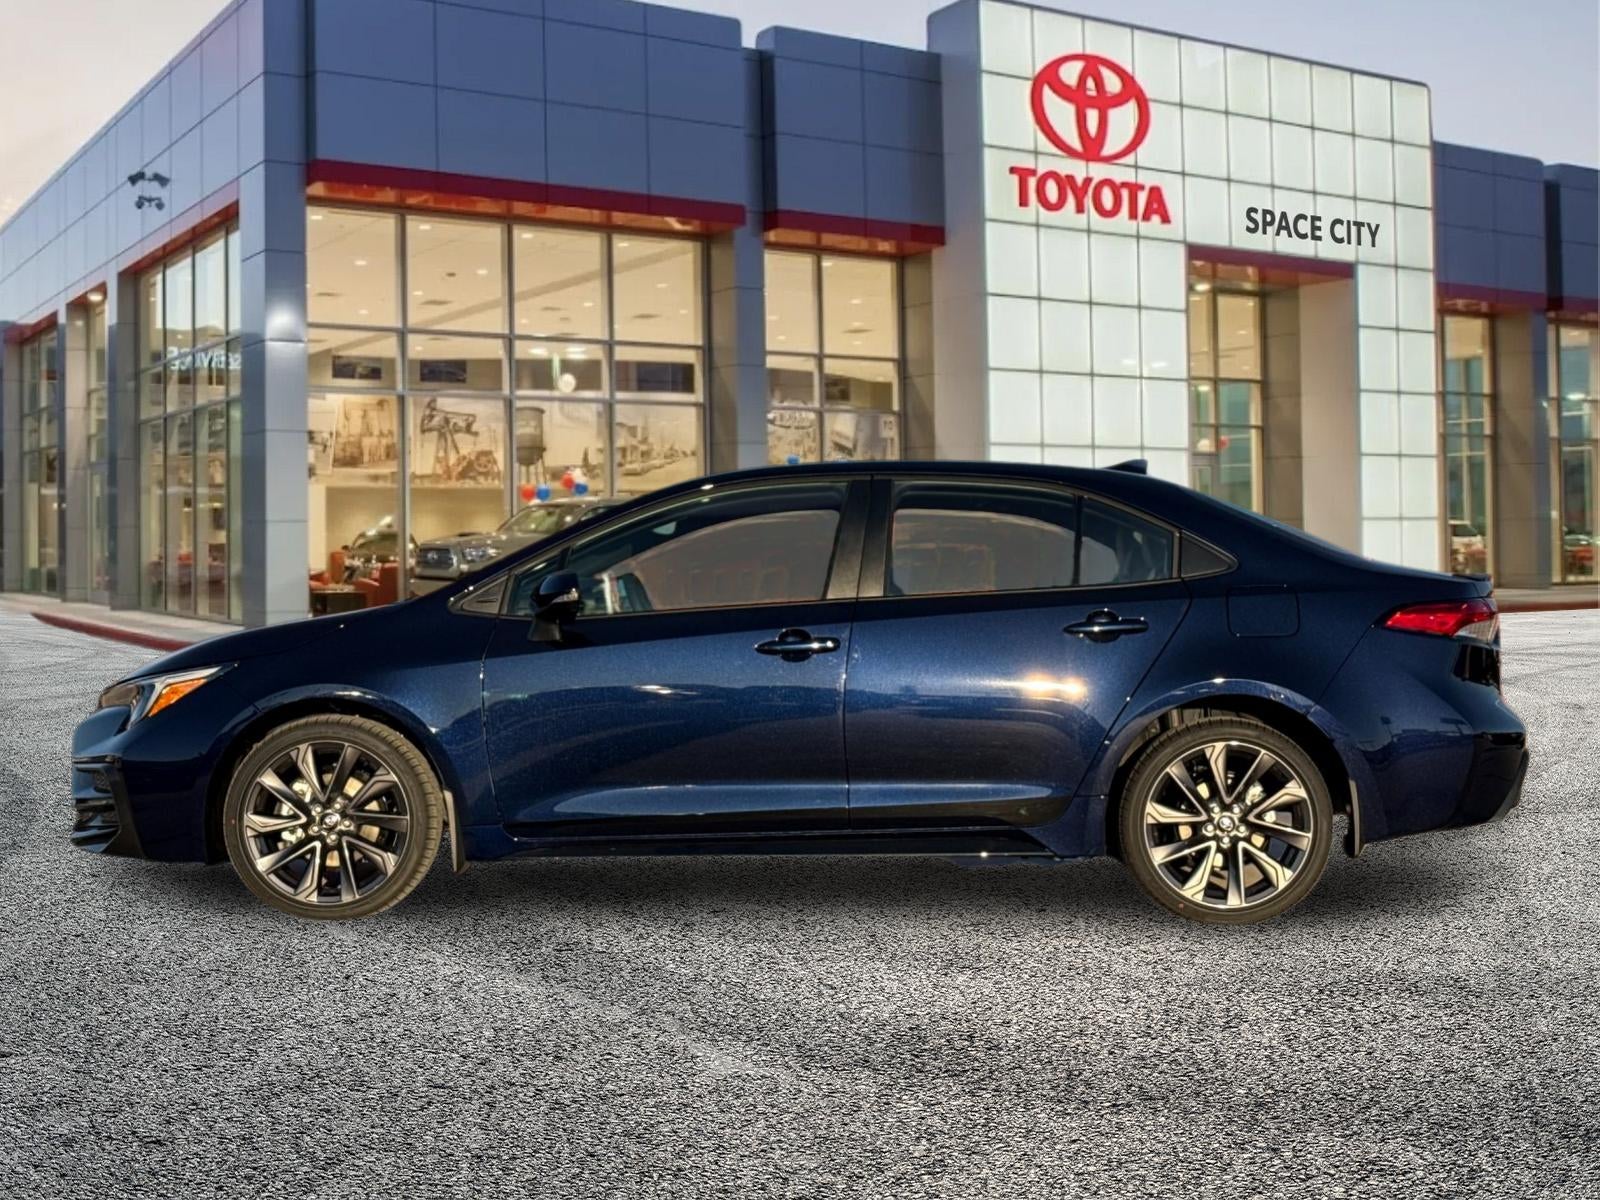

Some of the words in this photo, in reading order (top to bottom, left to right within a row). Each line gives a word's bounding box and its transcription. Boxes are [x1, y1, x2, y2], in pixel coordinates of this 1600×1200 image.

[1009, 166, 1172, 225] TOYOTA
[1245, 206, 1323, 242] SPACE
[1329, 218, 1381, 248] CITY
